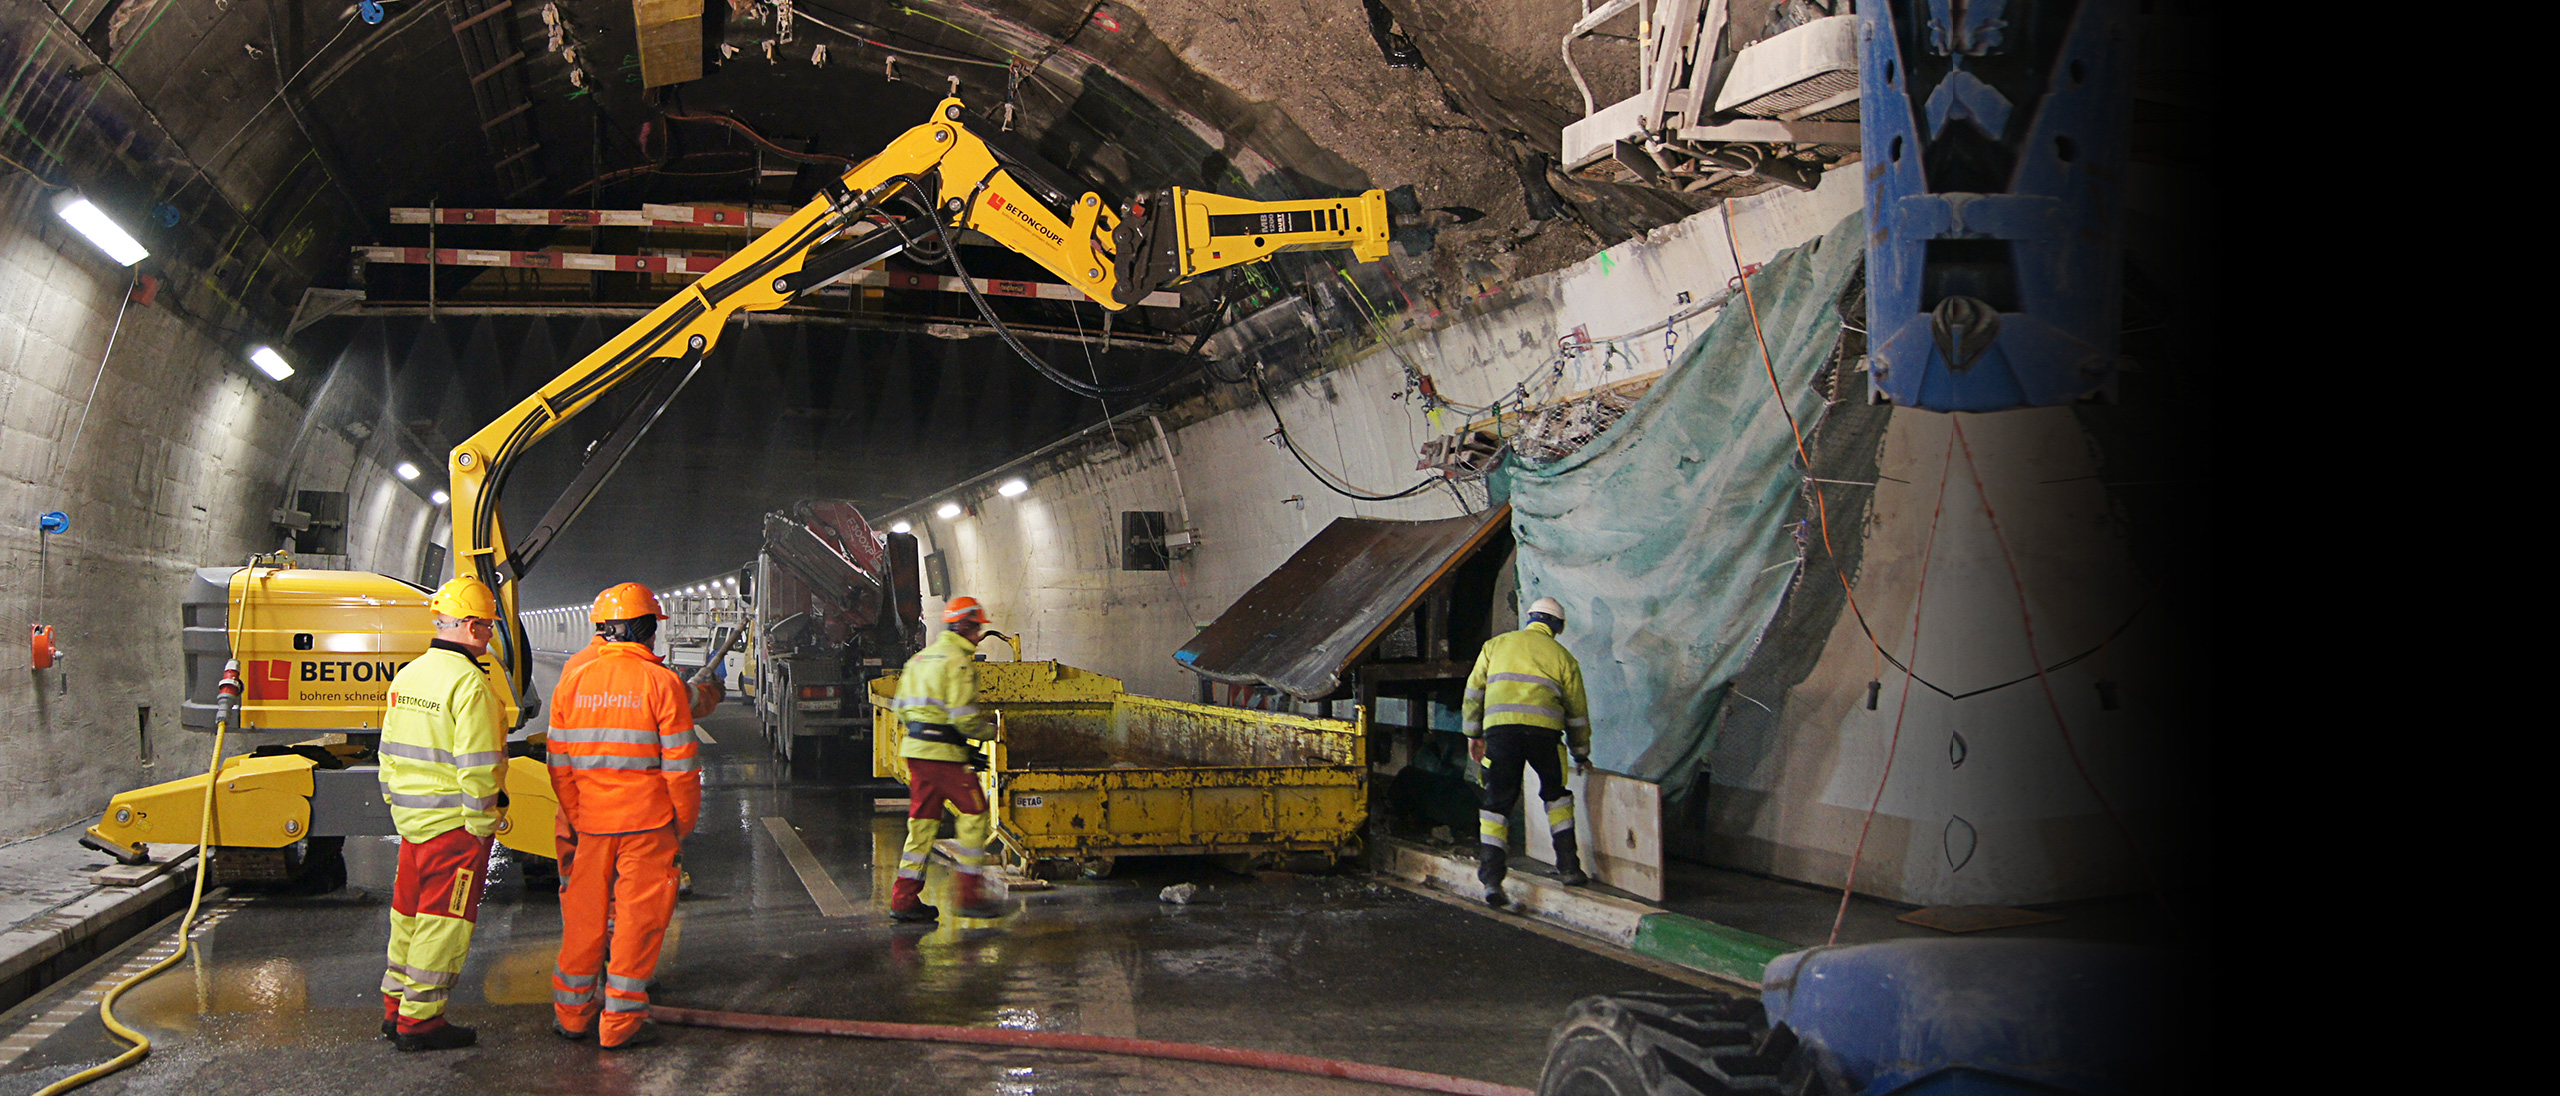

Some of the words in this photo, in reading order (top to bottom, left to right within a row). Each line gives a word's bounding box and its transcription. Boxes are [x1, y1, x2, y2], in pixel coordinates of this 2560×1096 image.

[1005, 203, 1065, 247] BETONCOUPE
[1260, 214, 1269, 233] MB
[300, 691, 341, 701] bohren
[344, 691, 387, 701] schneid
[397, 695, 441, 712] BETONCOUPE
[575, 690, 642, 712] Implenia
